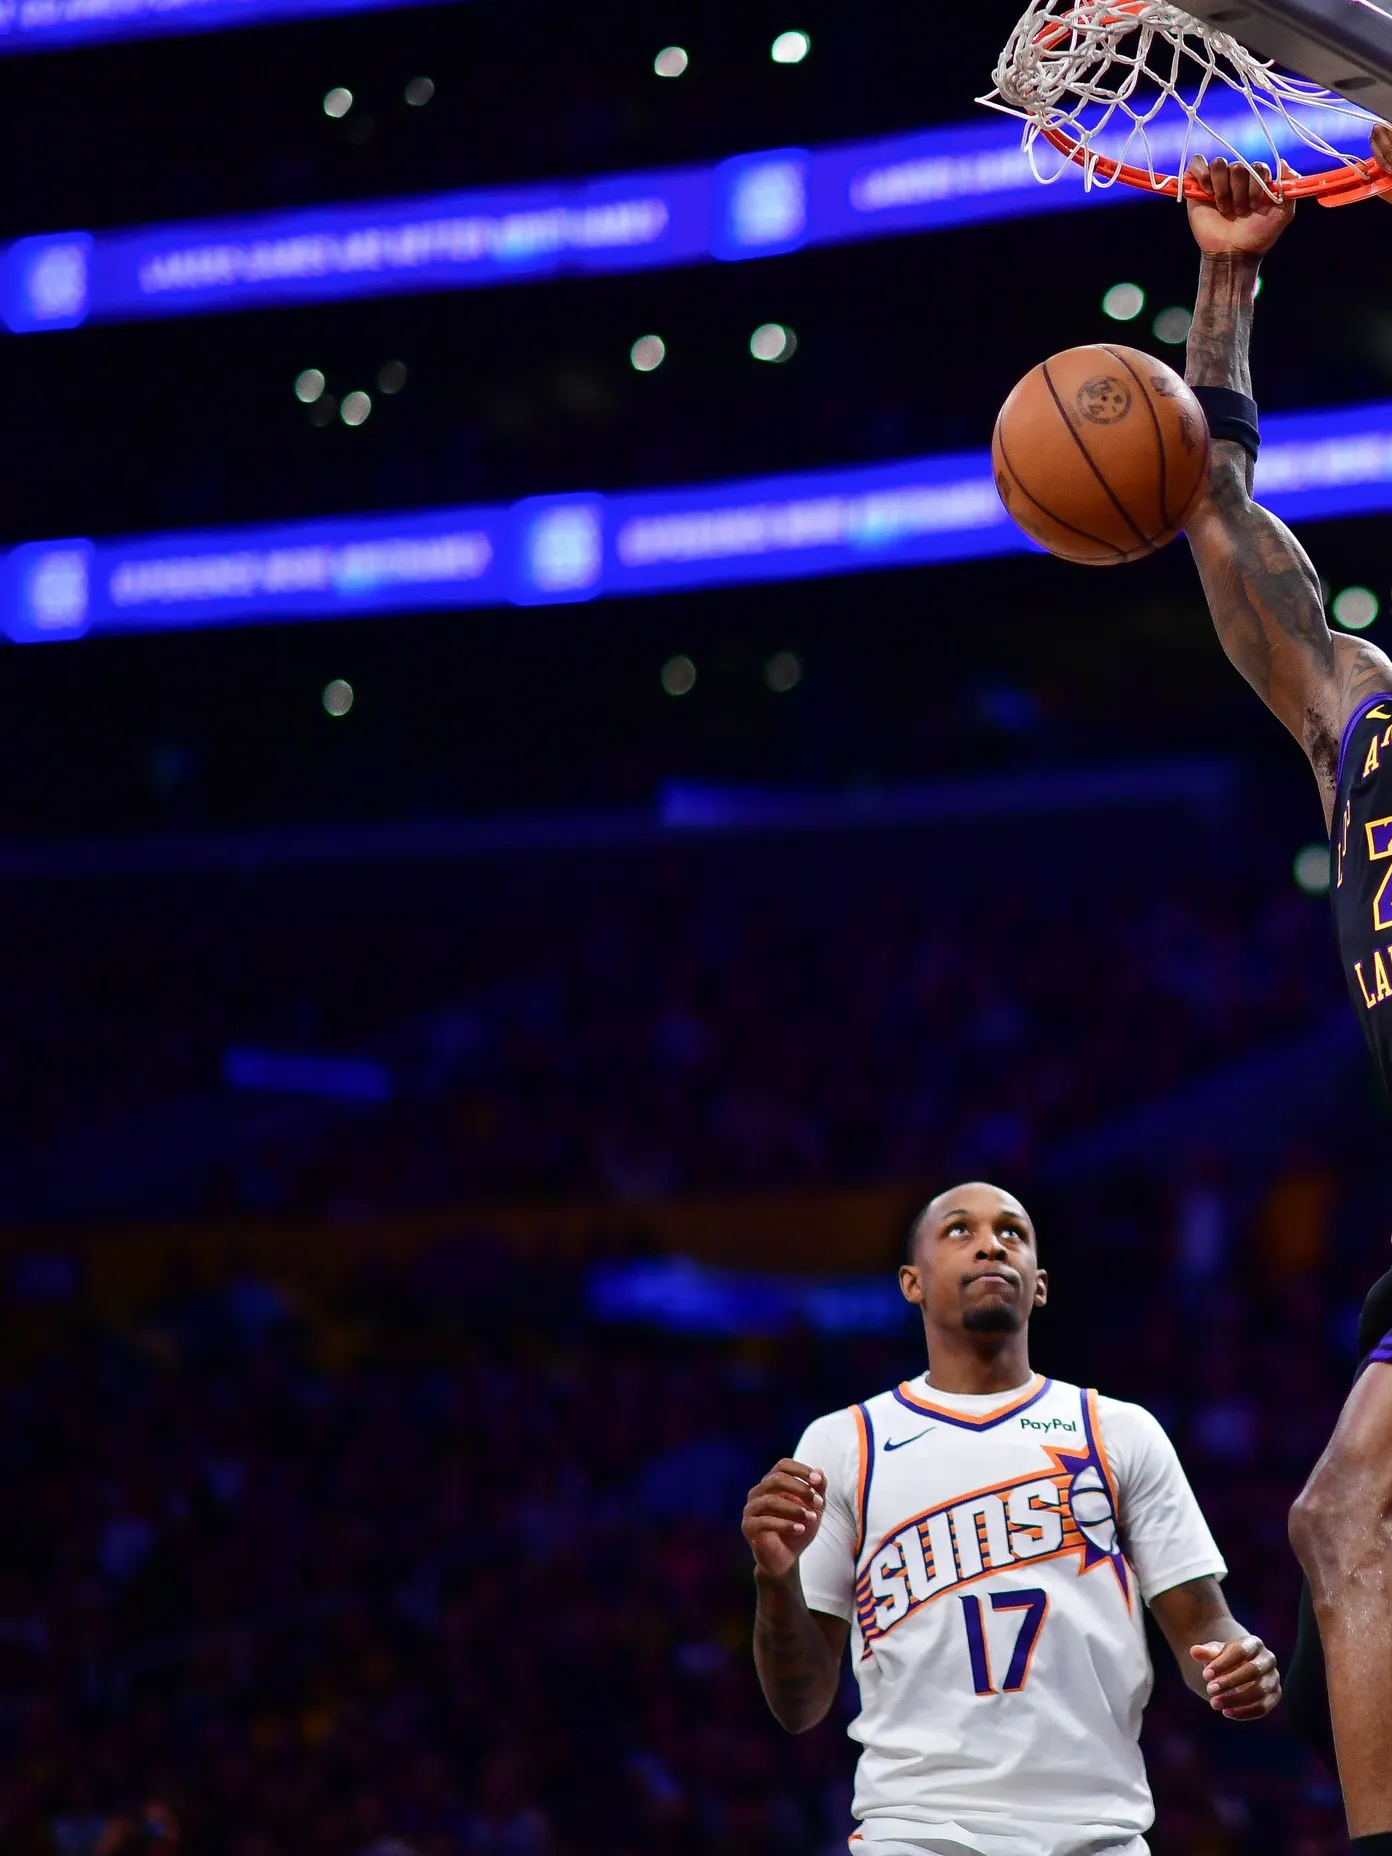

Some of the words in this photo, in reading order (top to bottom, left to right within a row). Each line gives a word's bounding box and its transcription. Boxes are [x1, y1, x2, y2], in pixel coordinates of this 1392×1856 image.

[1020, 1418, 1077, 1434] PayPal
[869, 1479, 1063, 1631] SUNS
[959, 1588, 1049, 1696] 17
